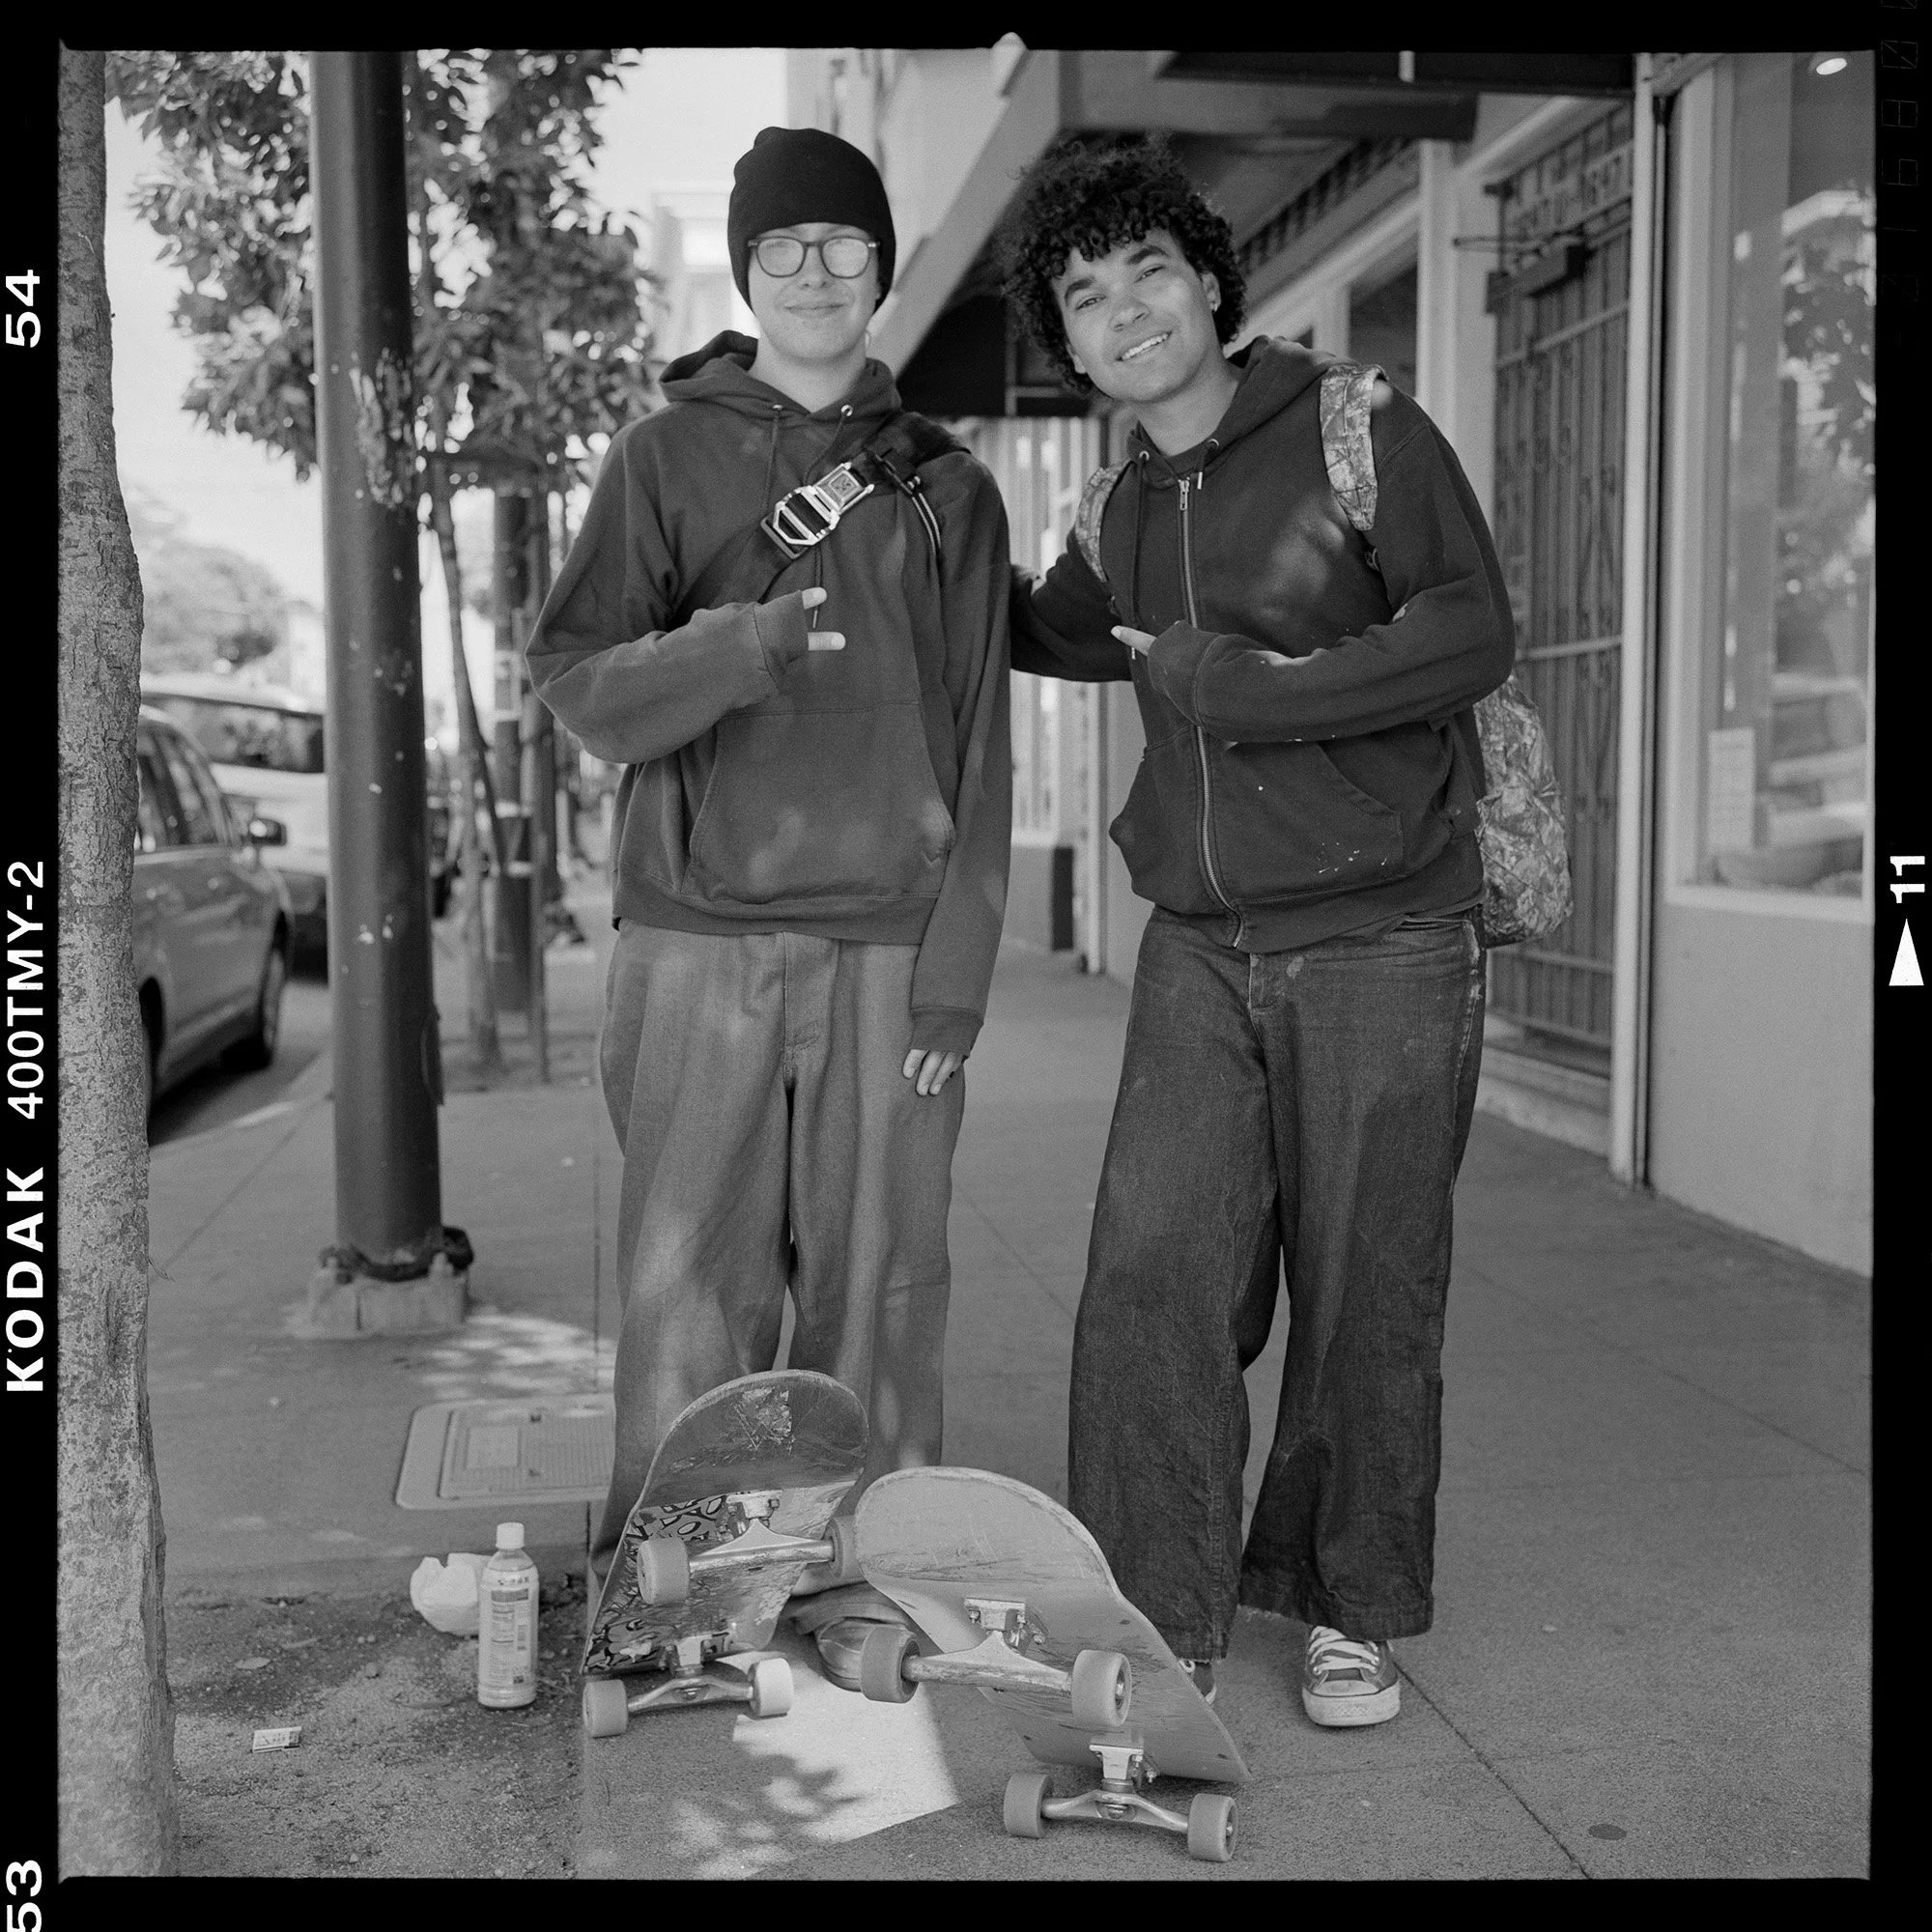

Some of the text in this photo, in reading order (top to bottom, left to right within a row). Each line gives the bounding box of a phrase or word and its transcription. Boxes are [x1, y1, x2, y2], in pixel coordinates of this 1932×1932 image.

[5, 269, 42, 349] 54
[1889, 855, 1926, 904] 11
[5, 861, 44, 1392] KODAK 400TMY-2
[5, 1860, 43, 1932] 53
